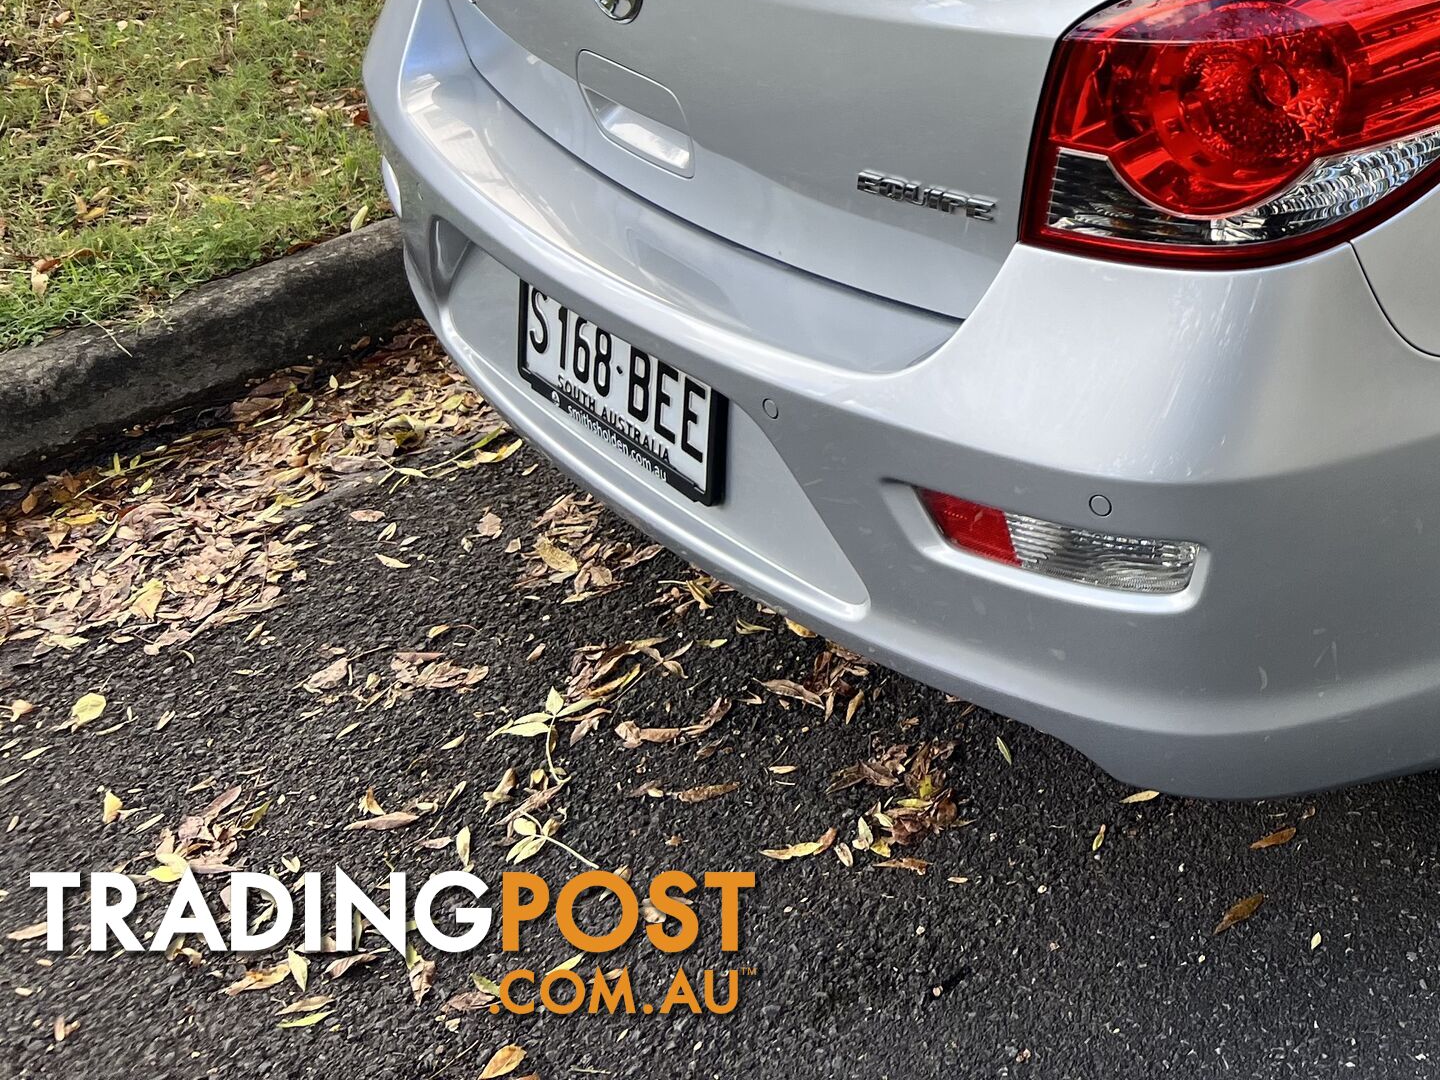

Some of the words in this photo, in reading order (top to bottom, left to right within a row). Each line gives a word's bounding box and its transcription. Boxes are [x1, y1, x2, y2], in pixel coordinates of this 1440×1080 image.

[557, 374, 596, 412] SOUTH
[600, 406, 670, 463] AUSTRALIA
[567, 404, 668, 482] smithsholden.com.au
